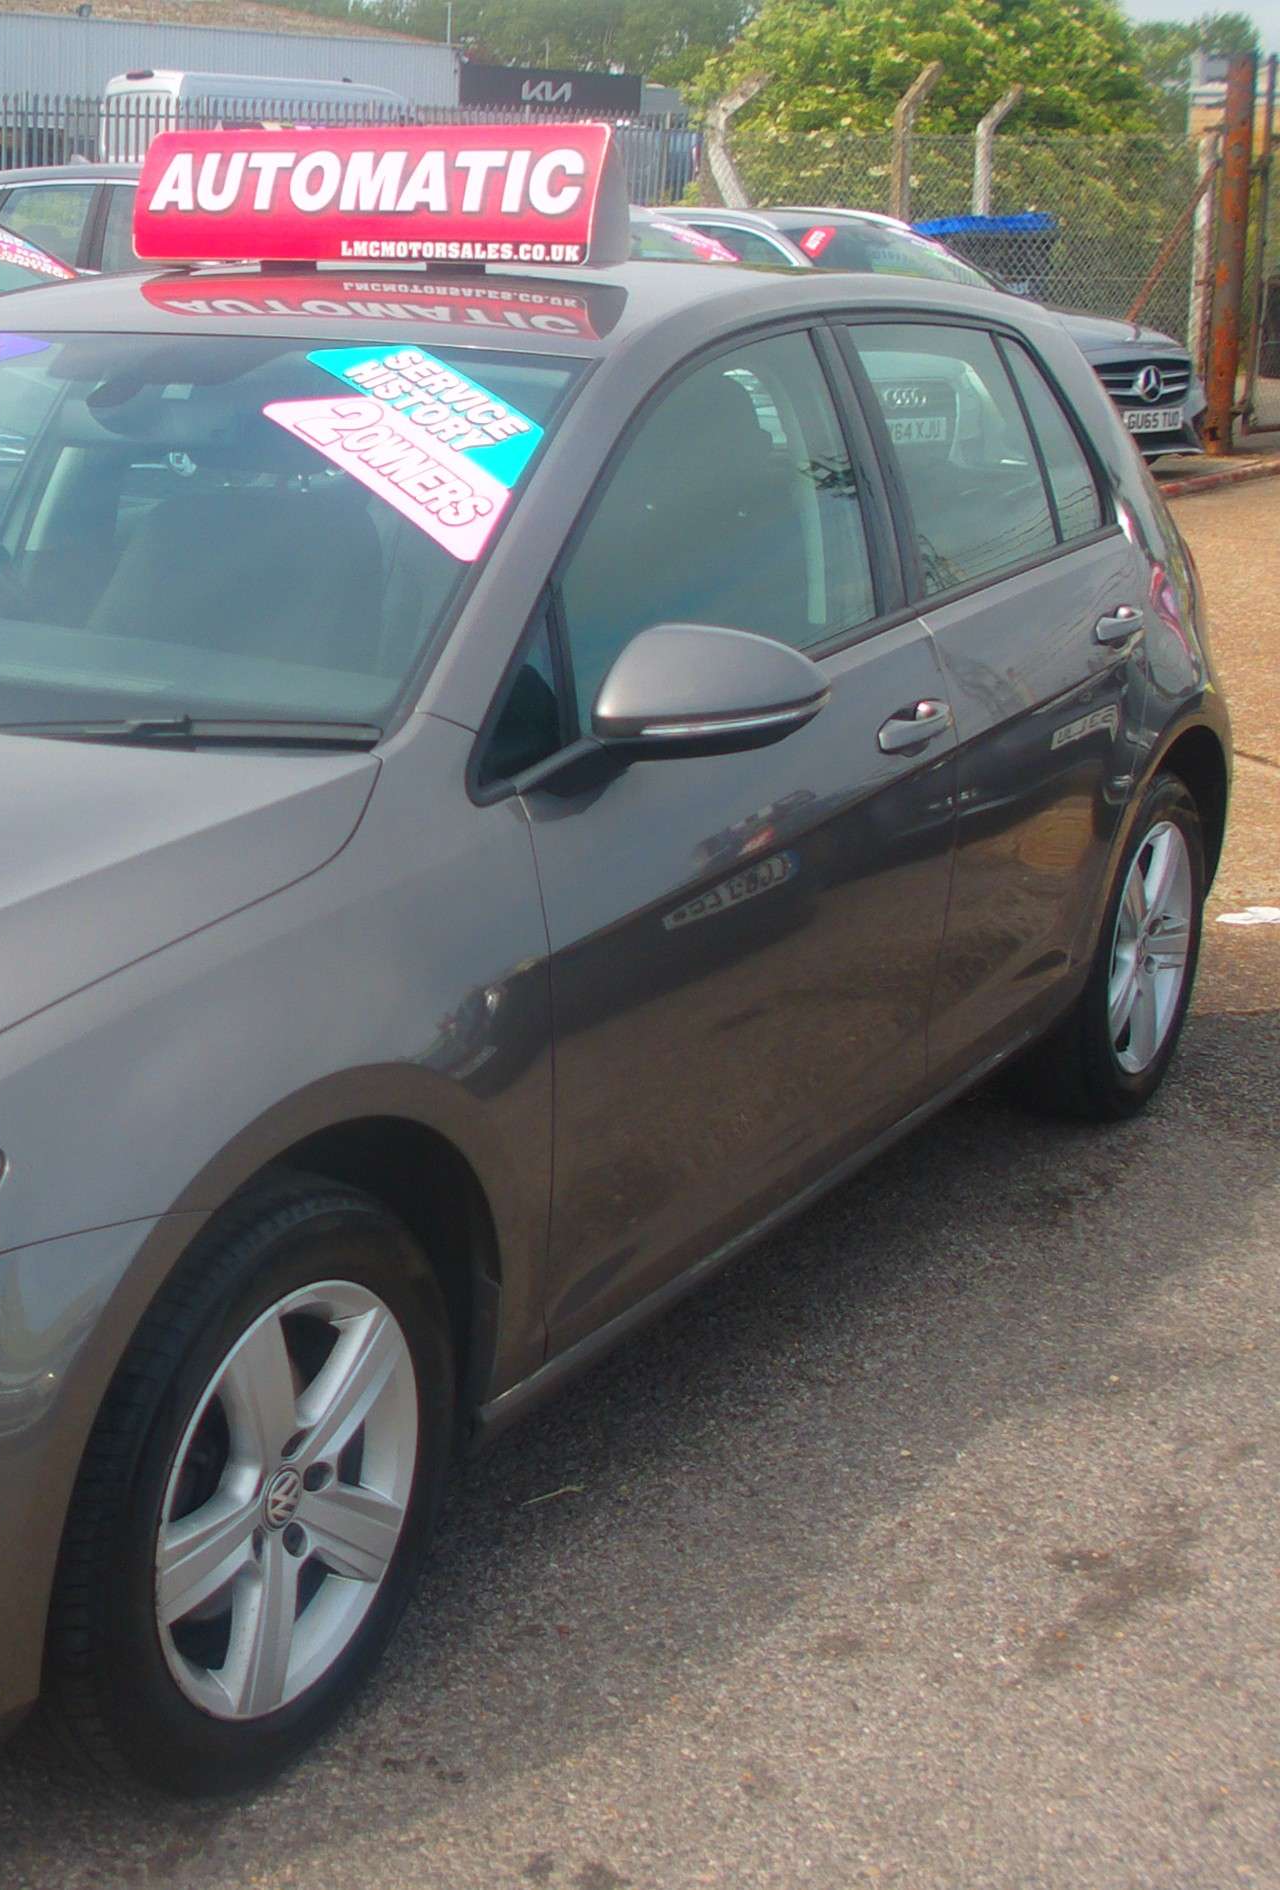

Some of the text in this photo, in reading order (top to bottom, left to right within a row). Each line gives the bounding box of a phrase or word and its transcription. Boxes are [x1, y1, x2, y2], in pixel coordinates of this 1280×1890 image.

[148, 148, 586, 215] AUTOMATIC
[341, 240, 580, 263] LMCMOTORSALES.CO.UK
[343, 361, 497, 452] HISTORY
[383, 350, 532, 441] SERVICE
[293, 400, 494, 527] 2 OWNERS
